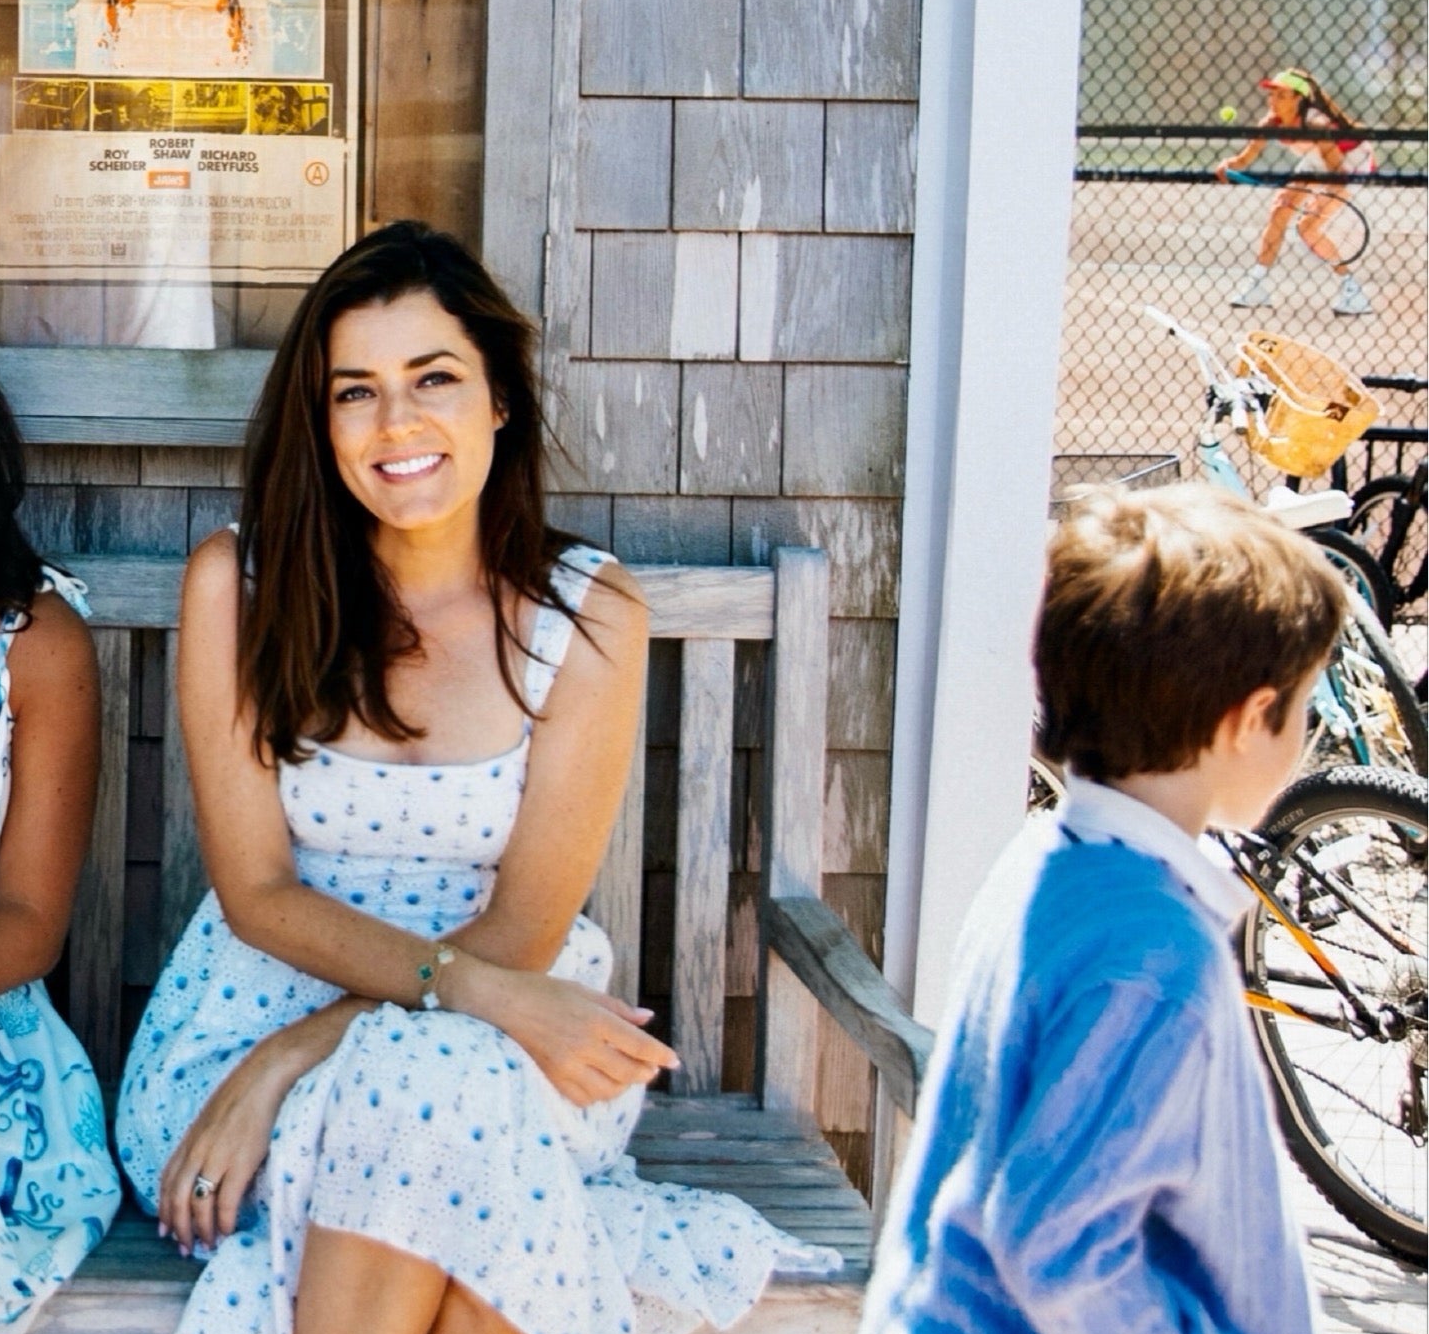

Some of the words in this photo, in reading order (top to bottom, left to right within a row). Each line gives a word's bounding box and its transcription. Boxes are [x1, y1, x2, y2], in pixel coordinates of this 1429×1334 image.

[149, 138, 195, 149] ROBERT
[104, 149, 129, 160] ROY
[153, 148, 192, 160] SHAW
[200, 150, 257, 161] RICHARD
[89, 160, 147, 171] SCHEIDER
[197, 161, 260, 173] DREYFUSS
[153, 175, 186, 187] JAWS
